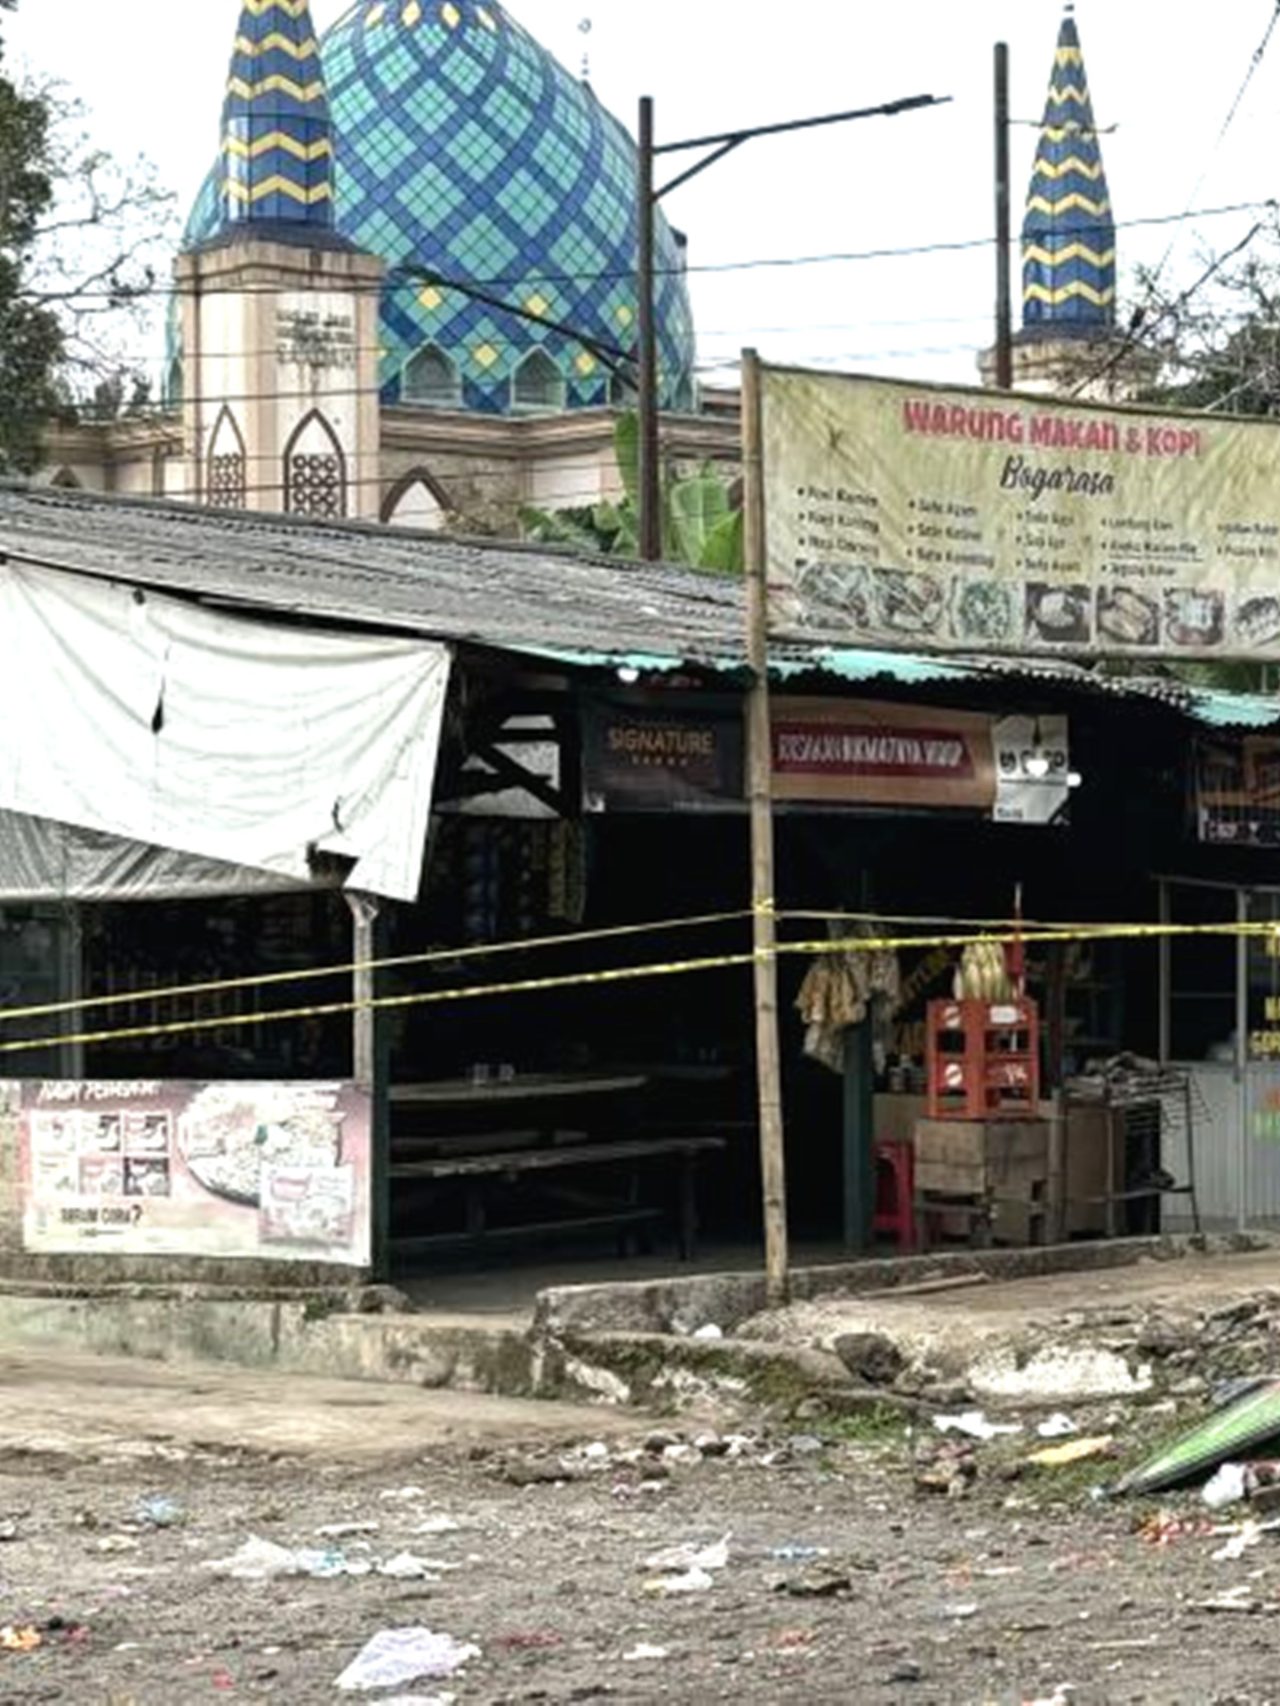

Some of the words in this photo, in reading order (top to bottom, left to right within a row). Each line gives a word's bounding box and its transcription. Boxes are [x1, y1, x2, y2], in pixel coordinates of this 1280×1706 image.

[904, 401, 1024, 444] WARUNG
[1030, 416, 1118, 450] MAKAN
[1126, 427, 1143, 452] &
[1147, 426, 1201, 456] KOPI
[1000, 454, 1115, 501] Bogarasa
[608, 726, 715, 755] SIGNATURE
